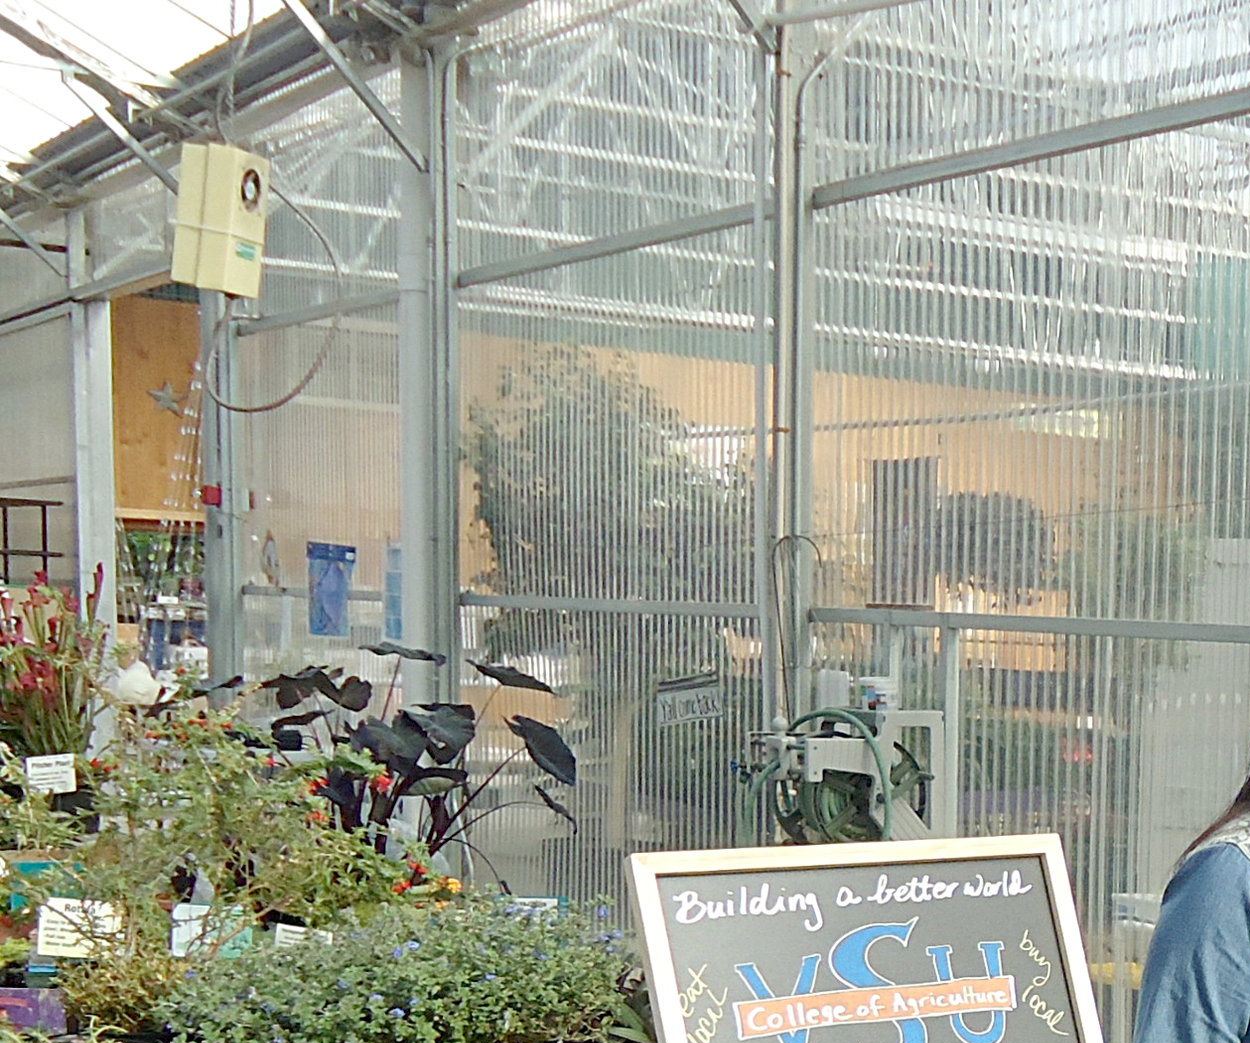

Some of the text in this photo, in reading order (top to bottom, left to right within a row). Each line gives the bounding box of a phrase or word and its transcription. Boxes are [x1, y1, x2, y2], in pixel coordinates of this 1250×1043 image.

[673, 882, 824, 931] Building
[836, 886, 862, 907] a
[867, 874, 957, 903] better
[1019, 929, 1051, 986] buy
[679, 964, 708, 1018] eat
[745, 986, 1009, 1032] College of Agriculture
[1022, 985, 1069, 1035] local
